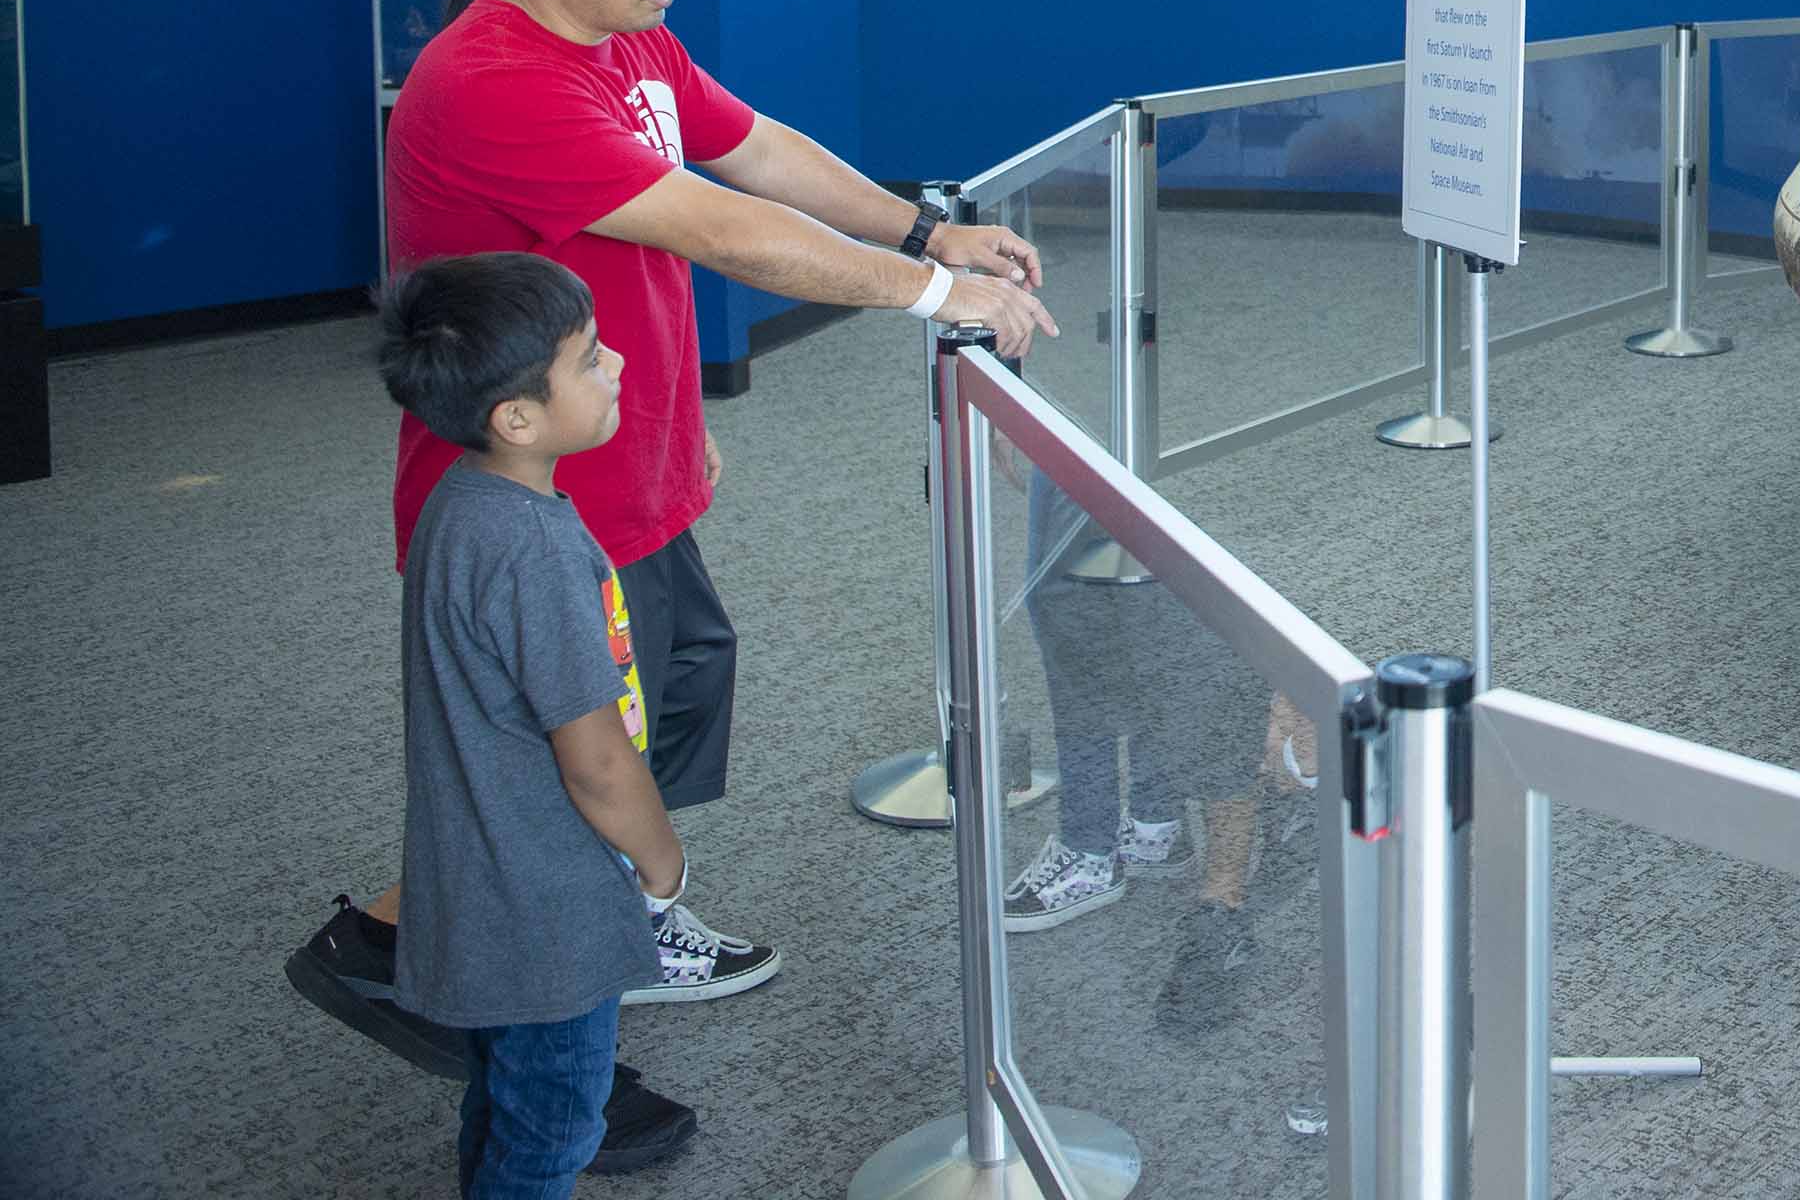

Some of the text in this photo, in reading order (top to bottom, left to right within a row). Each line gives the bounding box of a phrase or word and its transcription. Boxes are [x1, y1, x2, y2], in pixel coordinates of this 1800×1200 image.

[1435, 9, 1487, 26] that flew on the
[1427, 39, 1492, 61] first Saturn V launch
[1429, 73, 1444, 88] 1967
[1446, 77, 1452, 89] is
[1453, 80, 1462, 90] on
[1464, 77, 1478, 93] loan
[1480, 78, 1496, 96] from
[1429, 105, 1486, 128] the Smithsonian's
[1431, 138, 1483, 162] National Air and
[1431, 171, 1450, 189] Space
